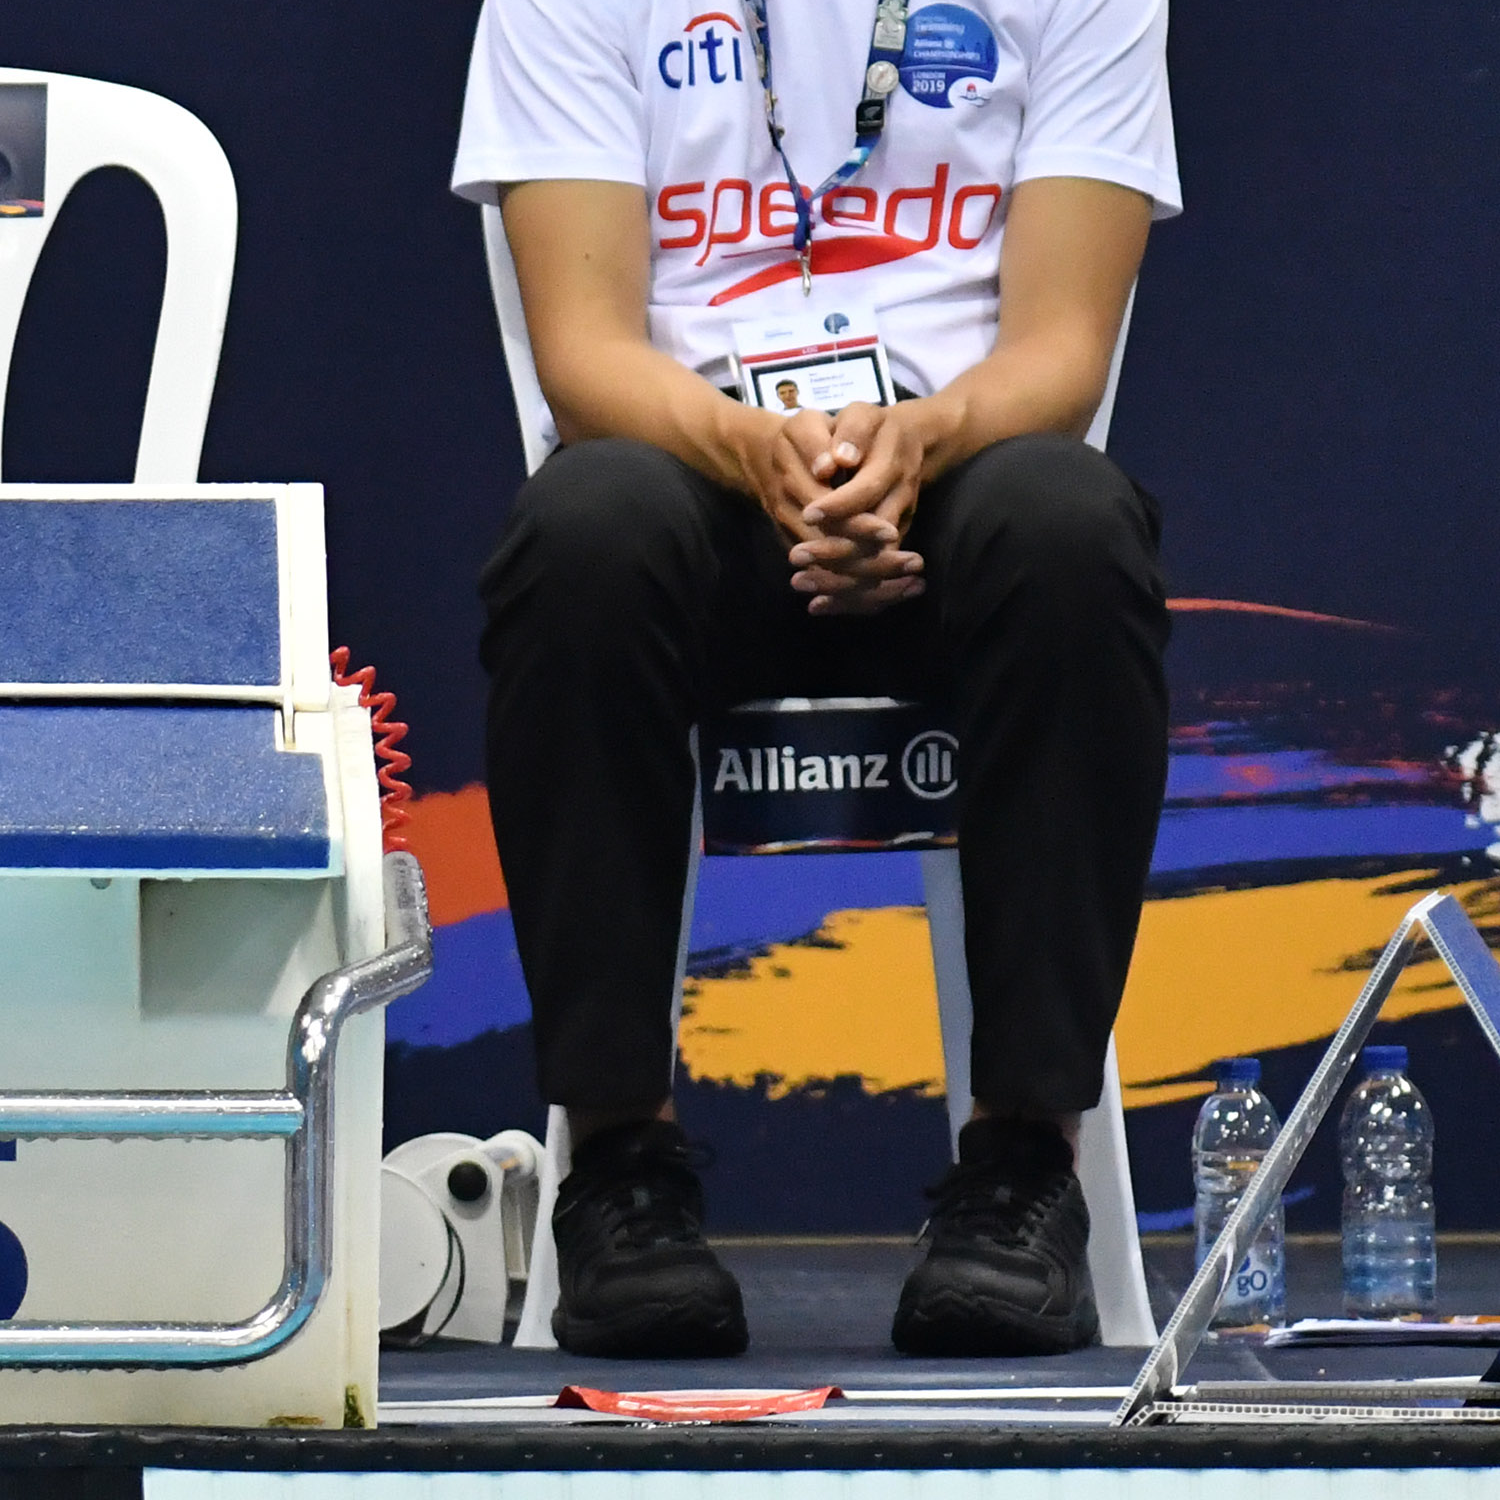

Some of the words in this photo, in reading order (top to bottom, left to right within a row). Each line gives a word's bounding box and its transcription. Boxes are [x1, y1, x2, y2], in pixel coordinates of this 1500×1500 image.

[658, 26, 743, 89] citi
[912, 80, 946, 93] 2019
[657, 163, 1002, 267] speedo
[713, 745, 890, 792] Allianz
